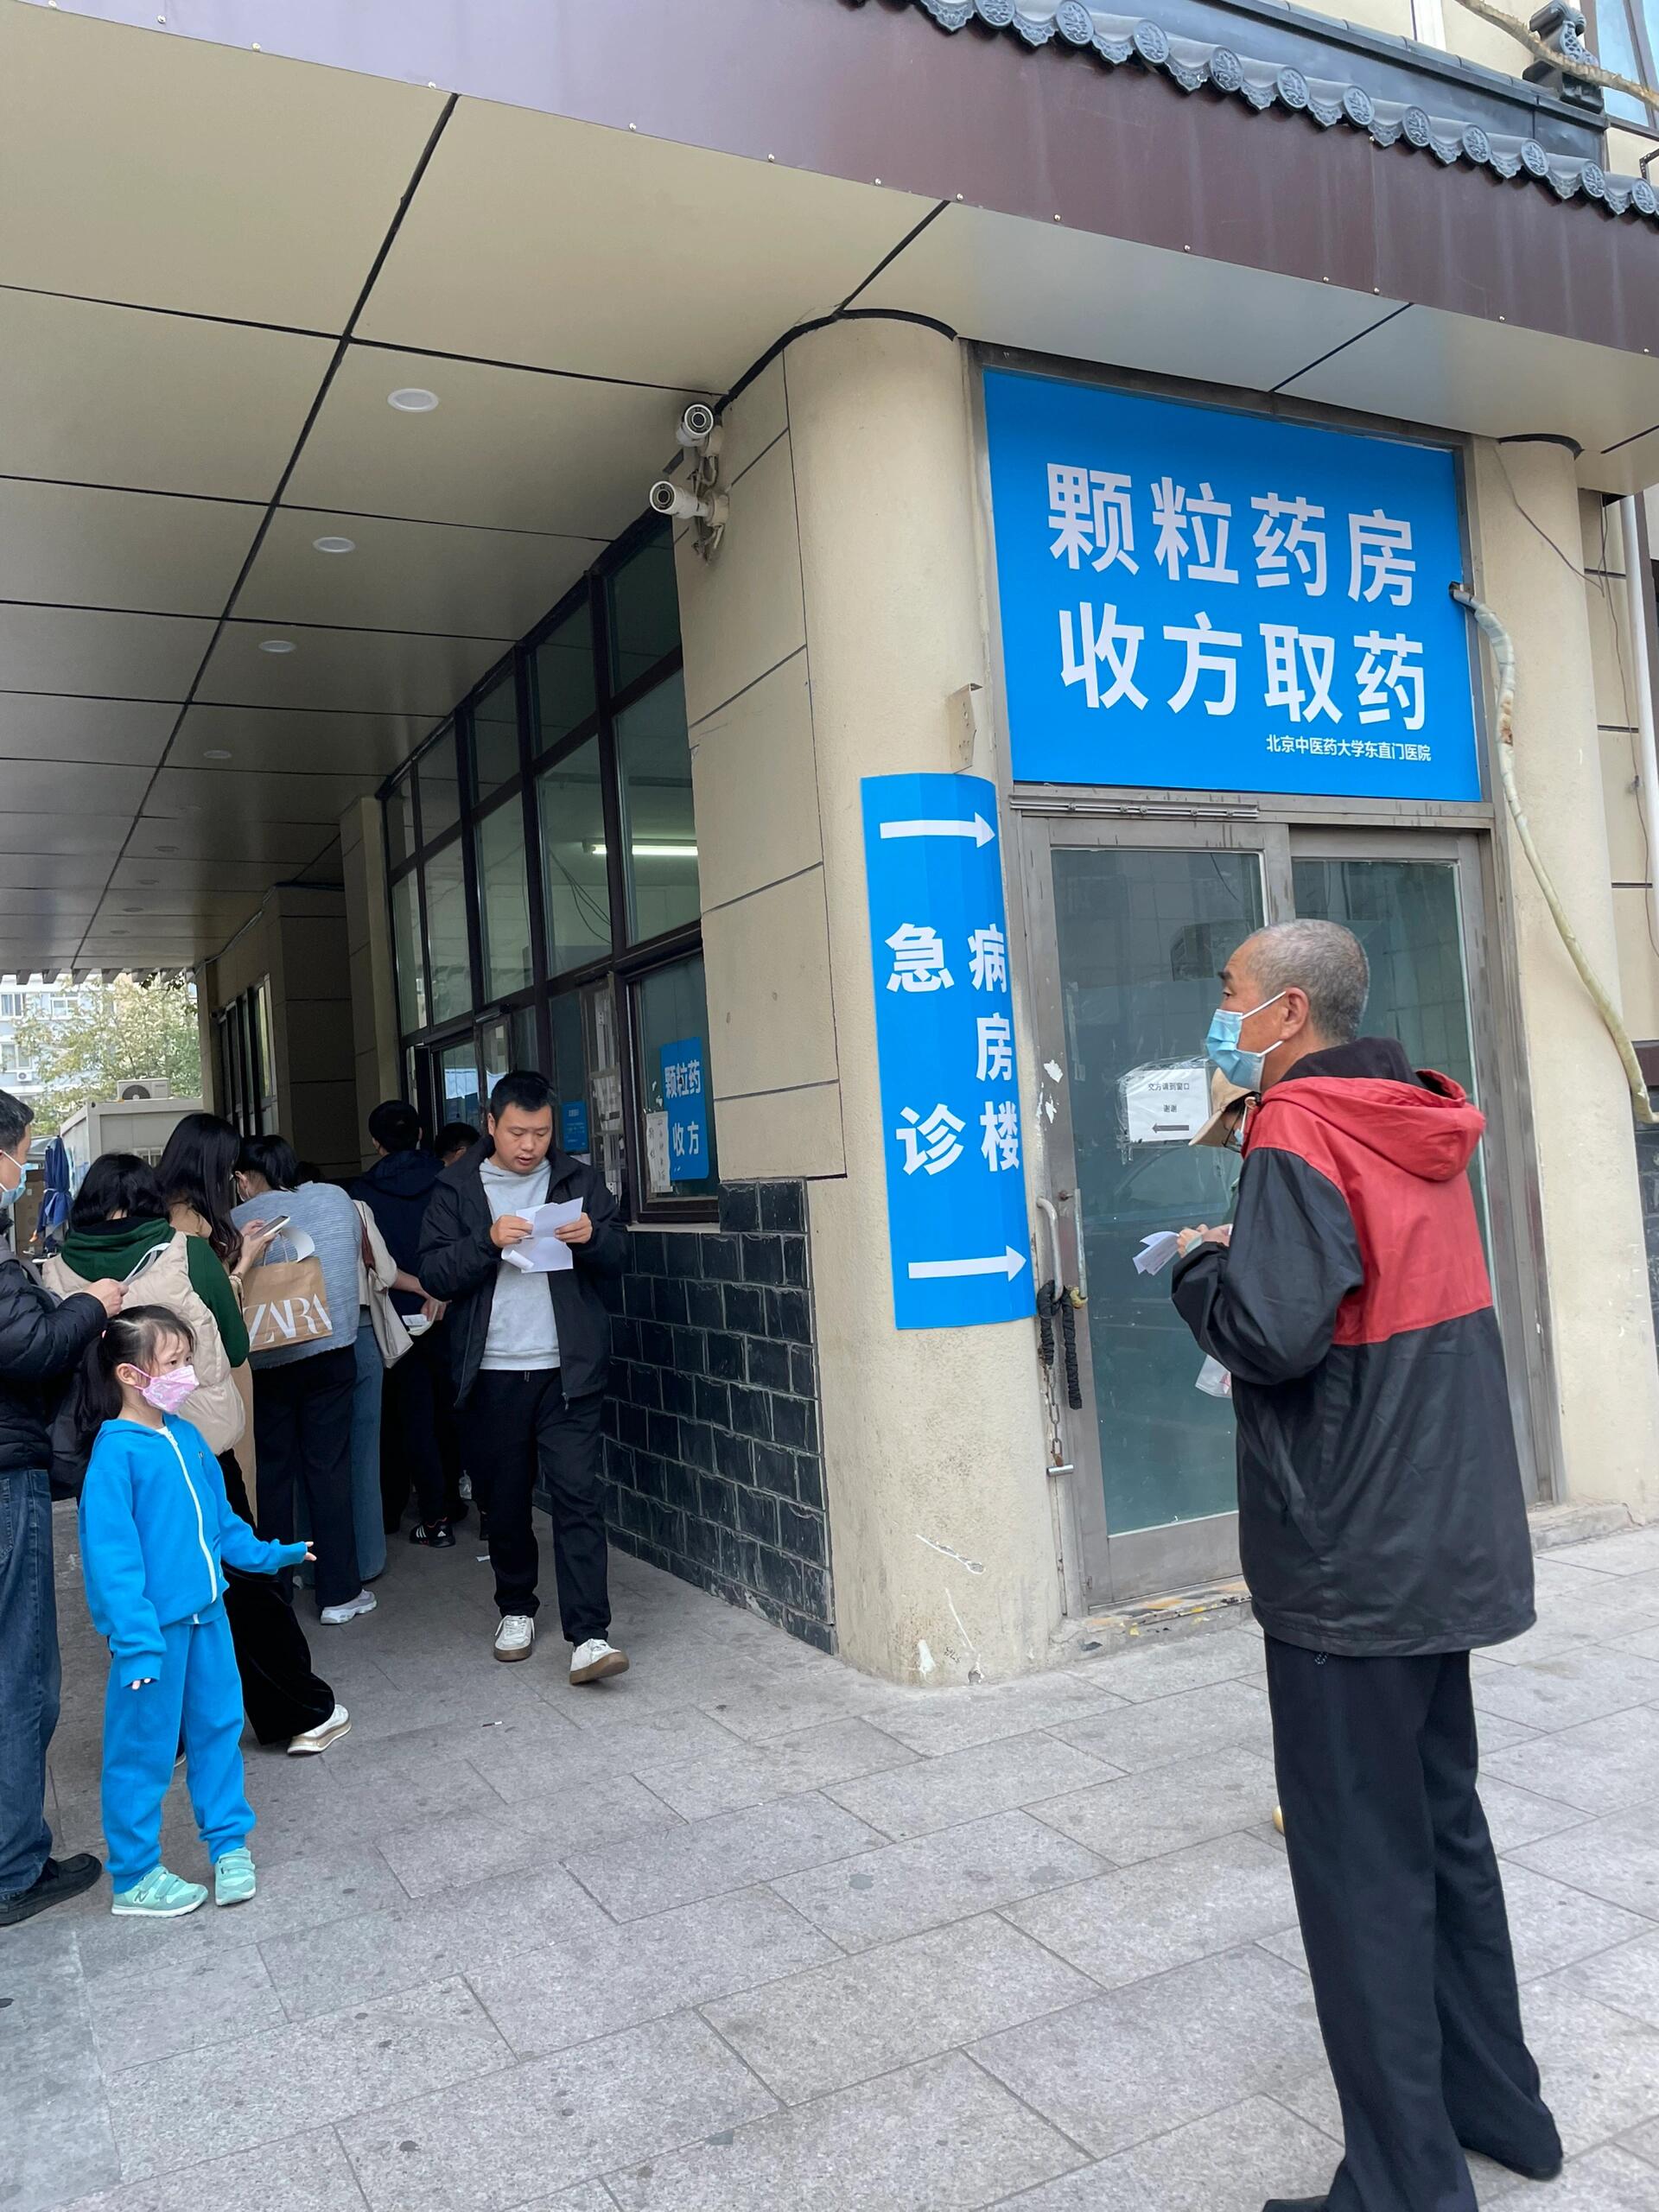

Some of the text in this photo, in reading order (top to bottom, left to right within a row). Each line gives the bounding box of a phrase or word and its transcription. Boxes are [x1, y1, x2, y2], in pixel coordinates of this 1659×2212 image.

[1047, 463, 1415, 606] 颗粒药房
[1059, 601, 1426, 730] 收方取药
[1266, 734, 1432, 761] 北京中医药大学东直门医院
[664, 1059, 701, 1099] 颗粒药
[885, 923, 966, 1176] 急诊
[969, 924, 1020, 1173] 病房楼
[672, 1121, 699, 1157] 收方
[243, 1294, 333, 1347] ZARA
